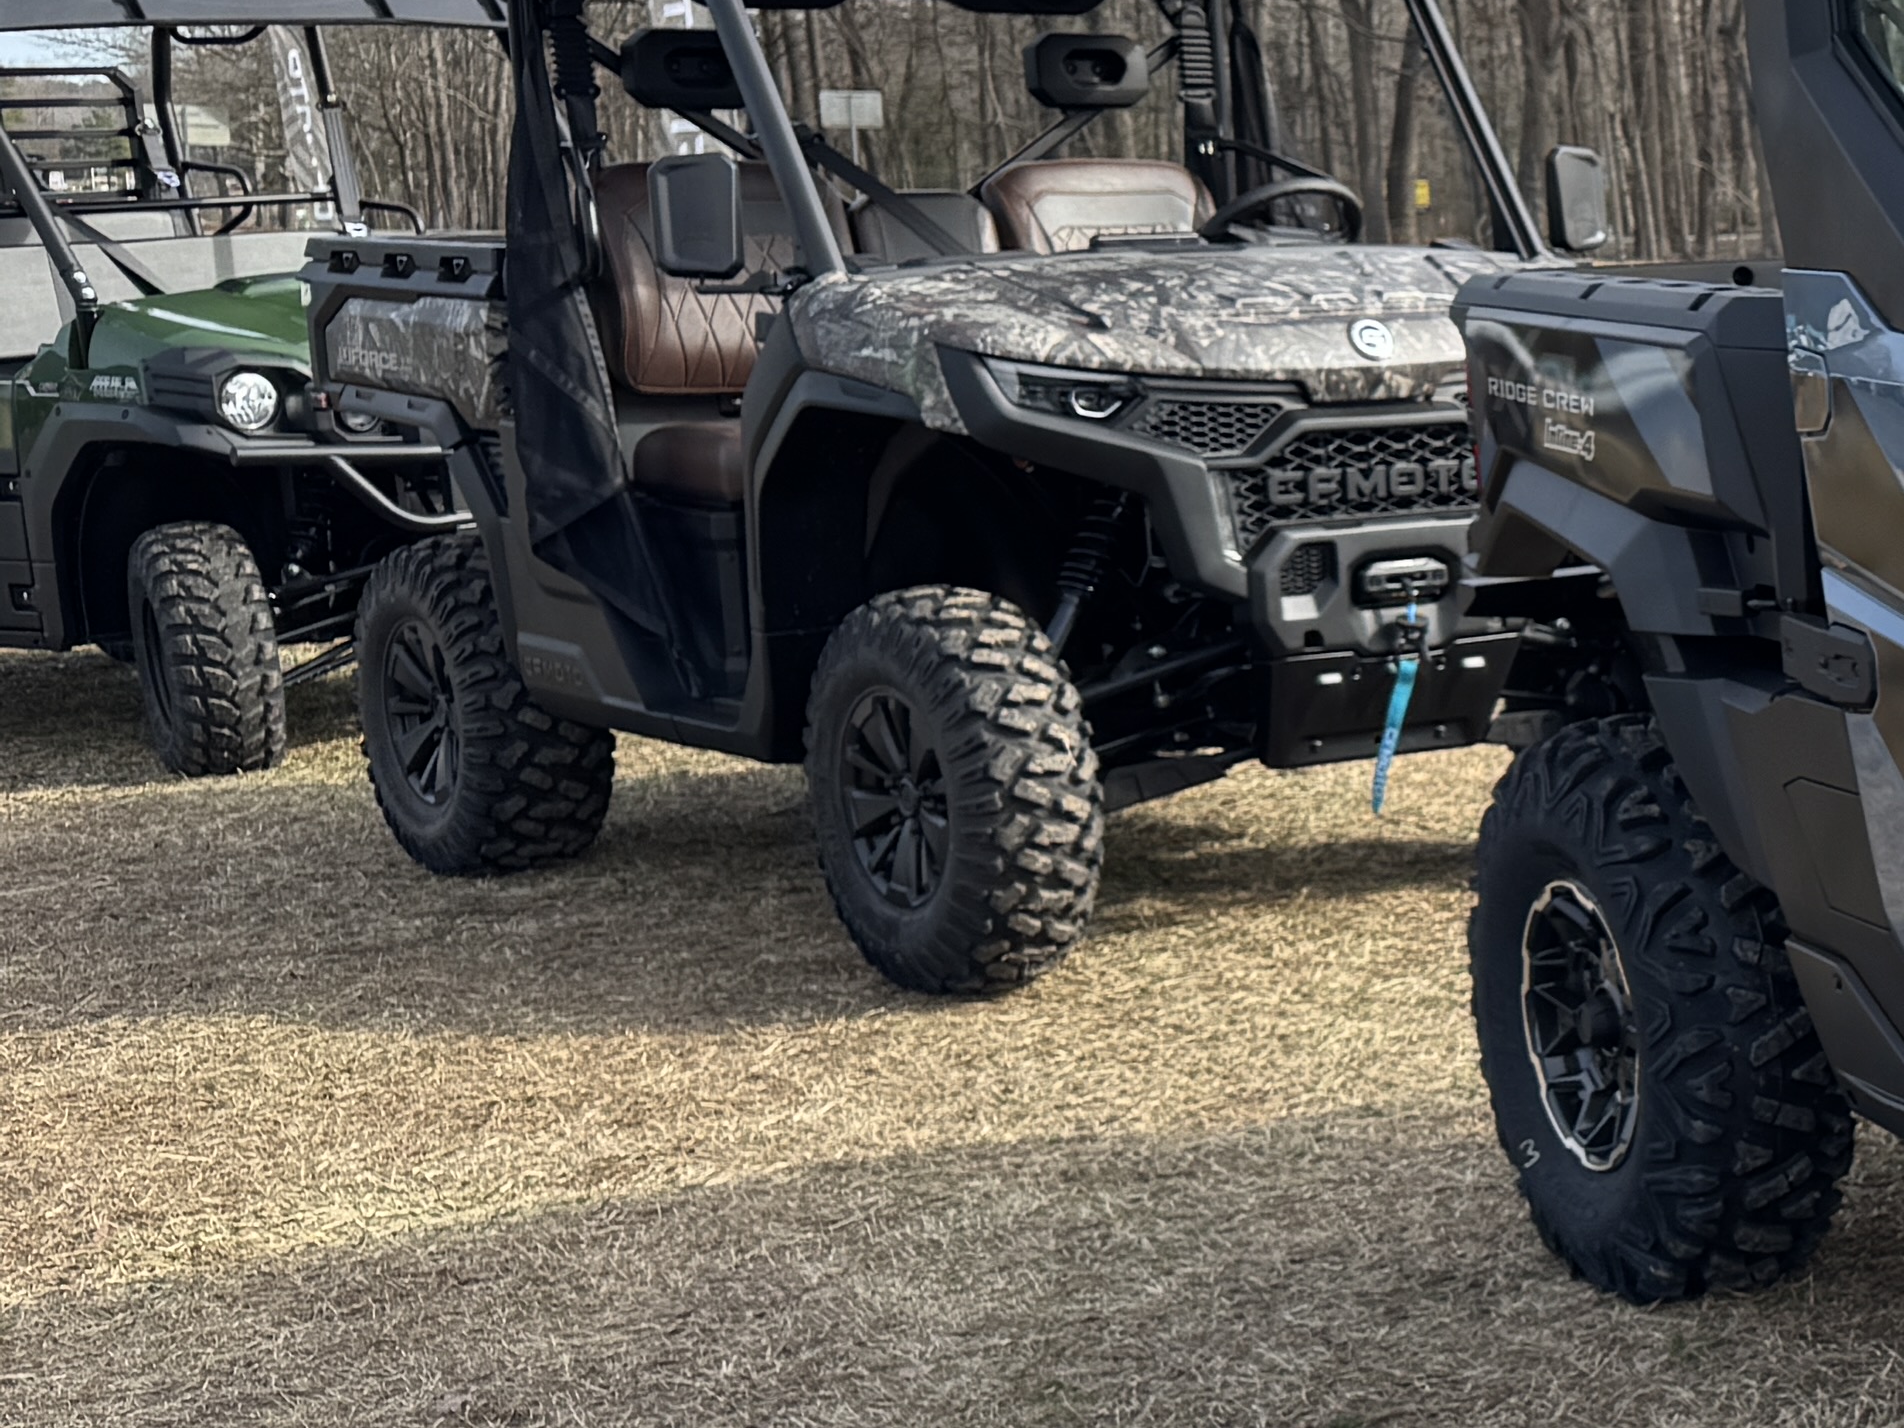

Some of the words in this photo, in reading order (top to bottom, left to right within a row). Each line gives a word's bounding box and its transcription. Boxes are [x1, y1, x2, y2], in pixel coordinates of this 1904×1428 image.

[1487, 376, 1538, 406] RIDGE
[1542, 388, 1595, 417] CREW
[1519, 1138, 1541, 1168] 3
